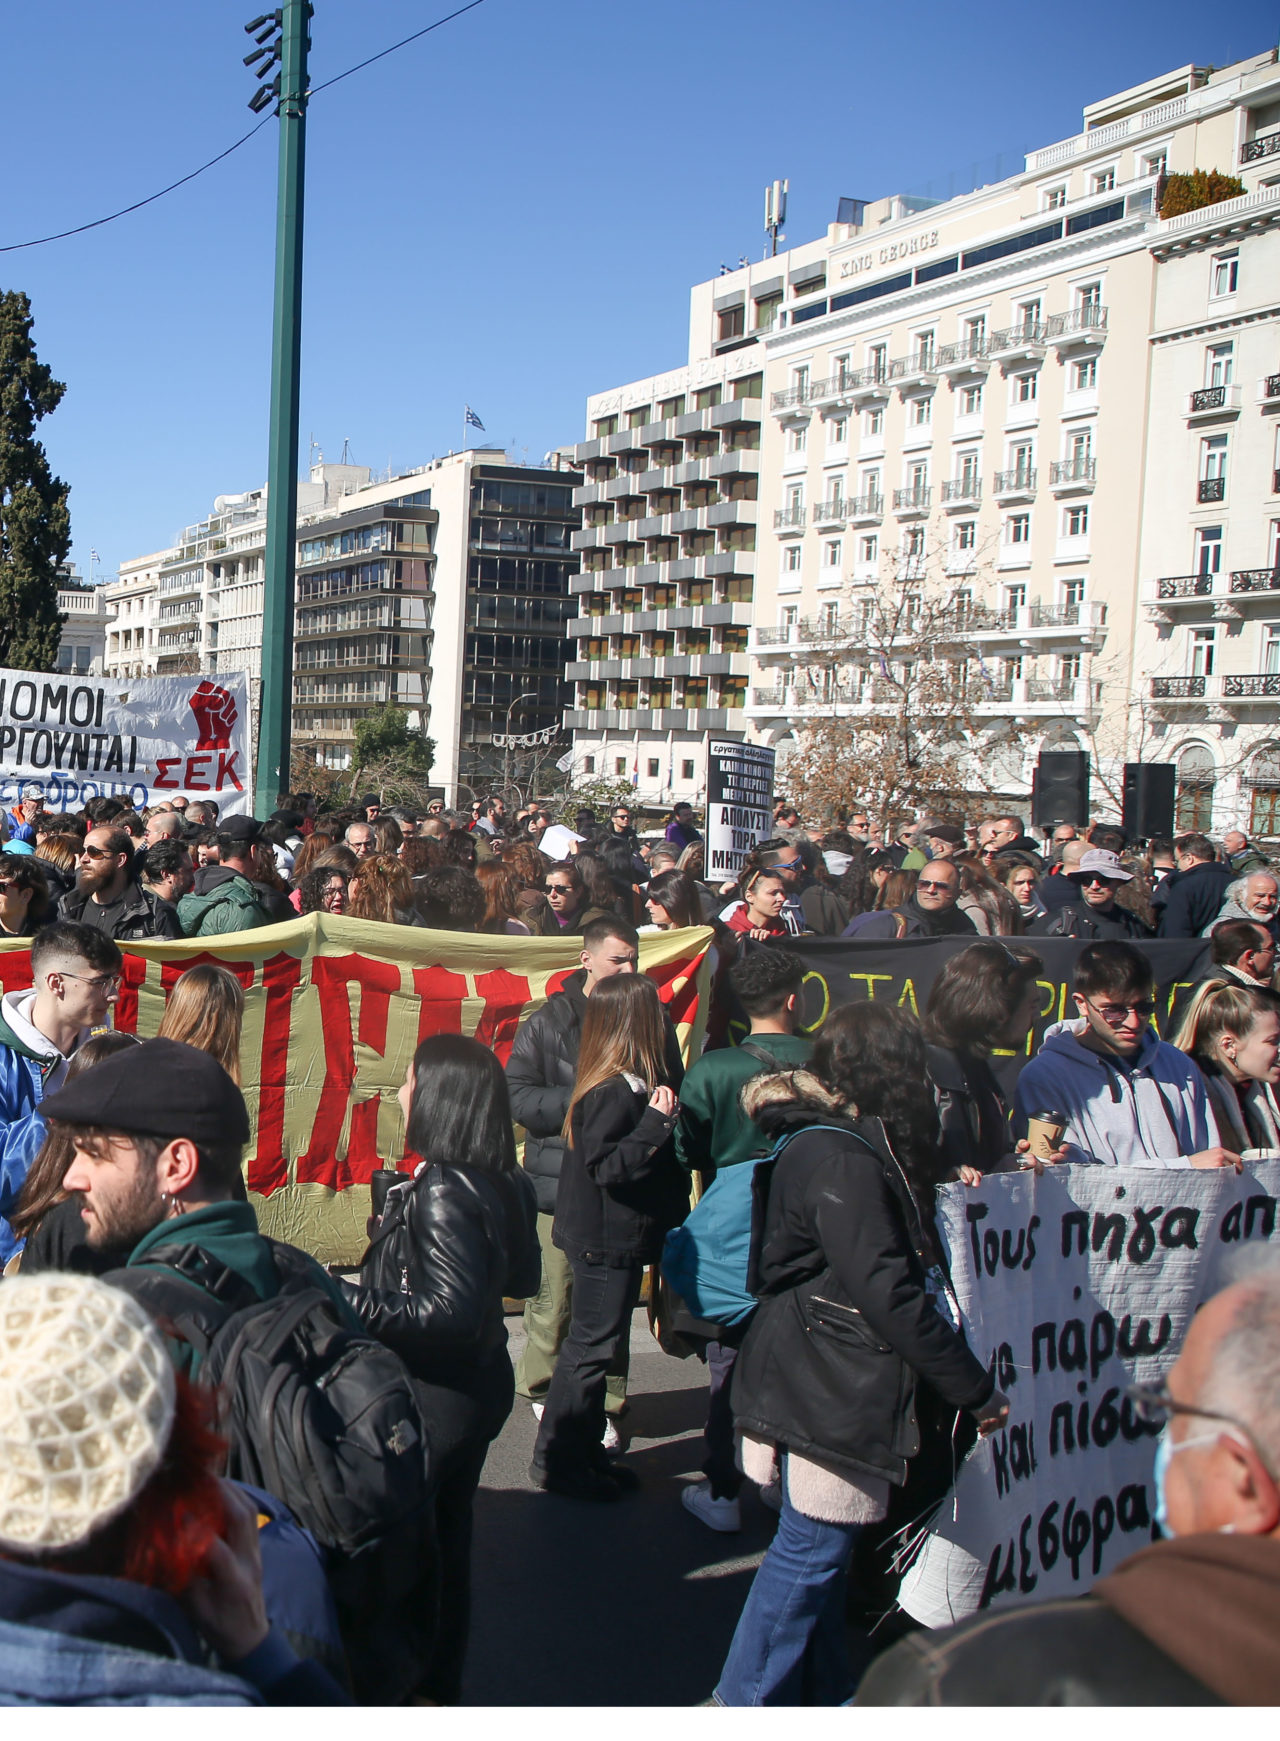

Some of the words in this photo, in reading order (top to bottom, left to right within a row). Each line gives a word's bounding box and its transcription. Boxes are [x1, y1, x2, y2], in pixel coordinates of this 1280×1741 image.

[840, 252, 873, 279] KING
[879, 230, 938, 264] GEORGE
[153, 751, 243, 791] ΣΕΚ
[731, 830, 756, 850] ΤΩΡΑ
[966, 1203, 1040, 1279] Τους
[992, 1419, 1037, 1499] και
